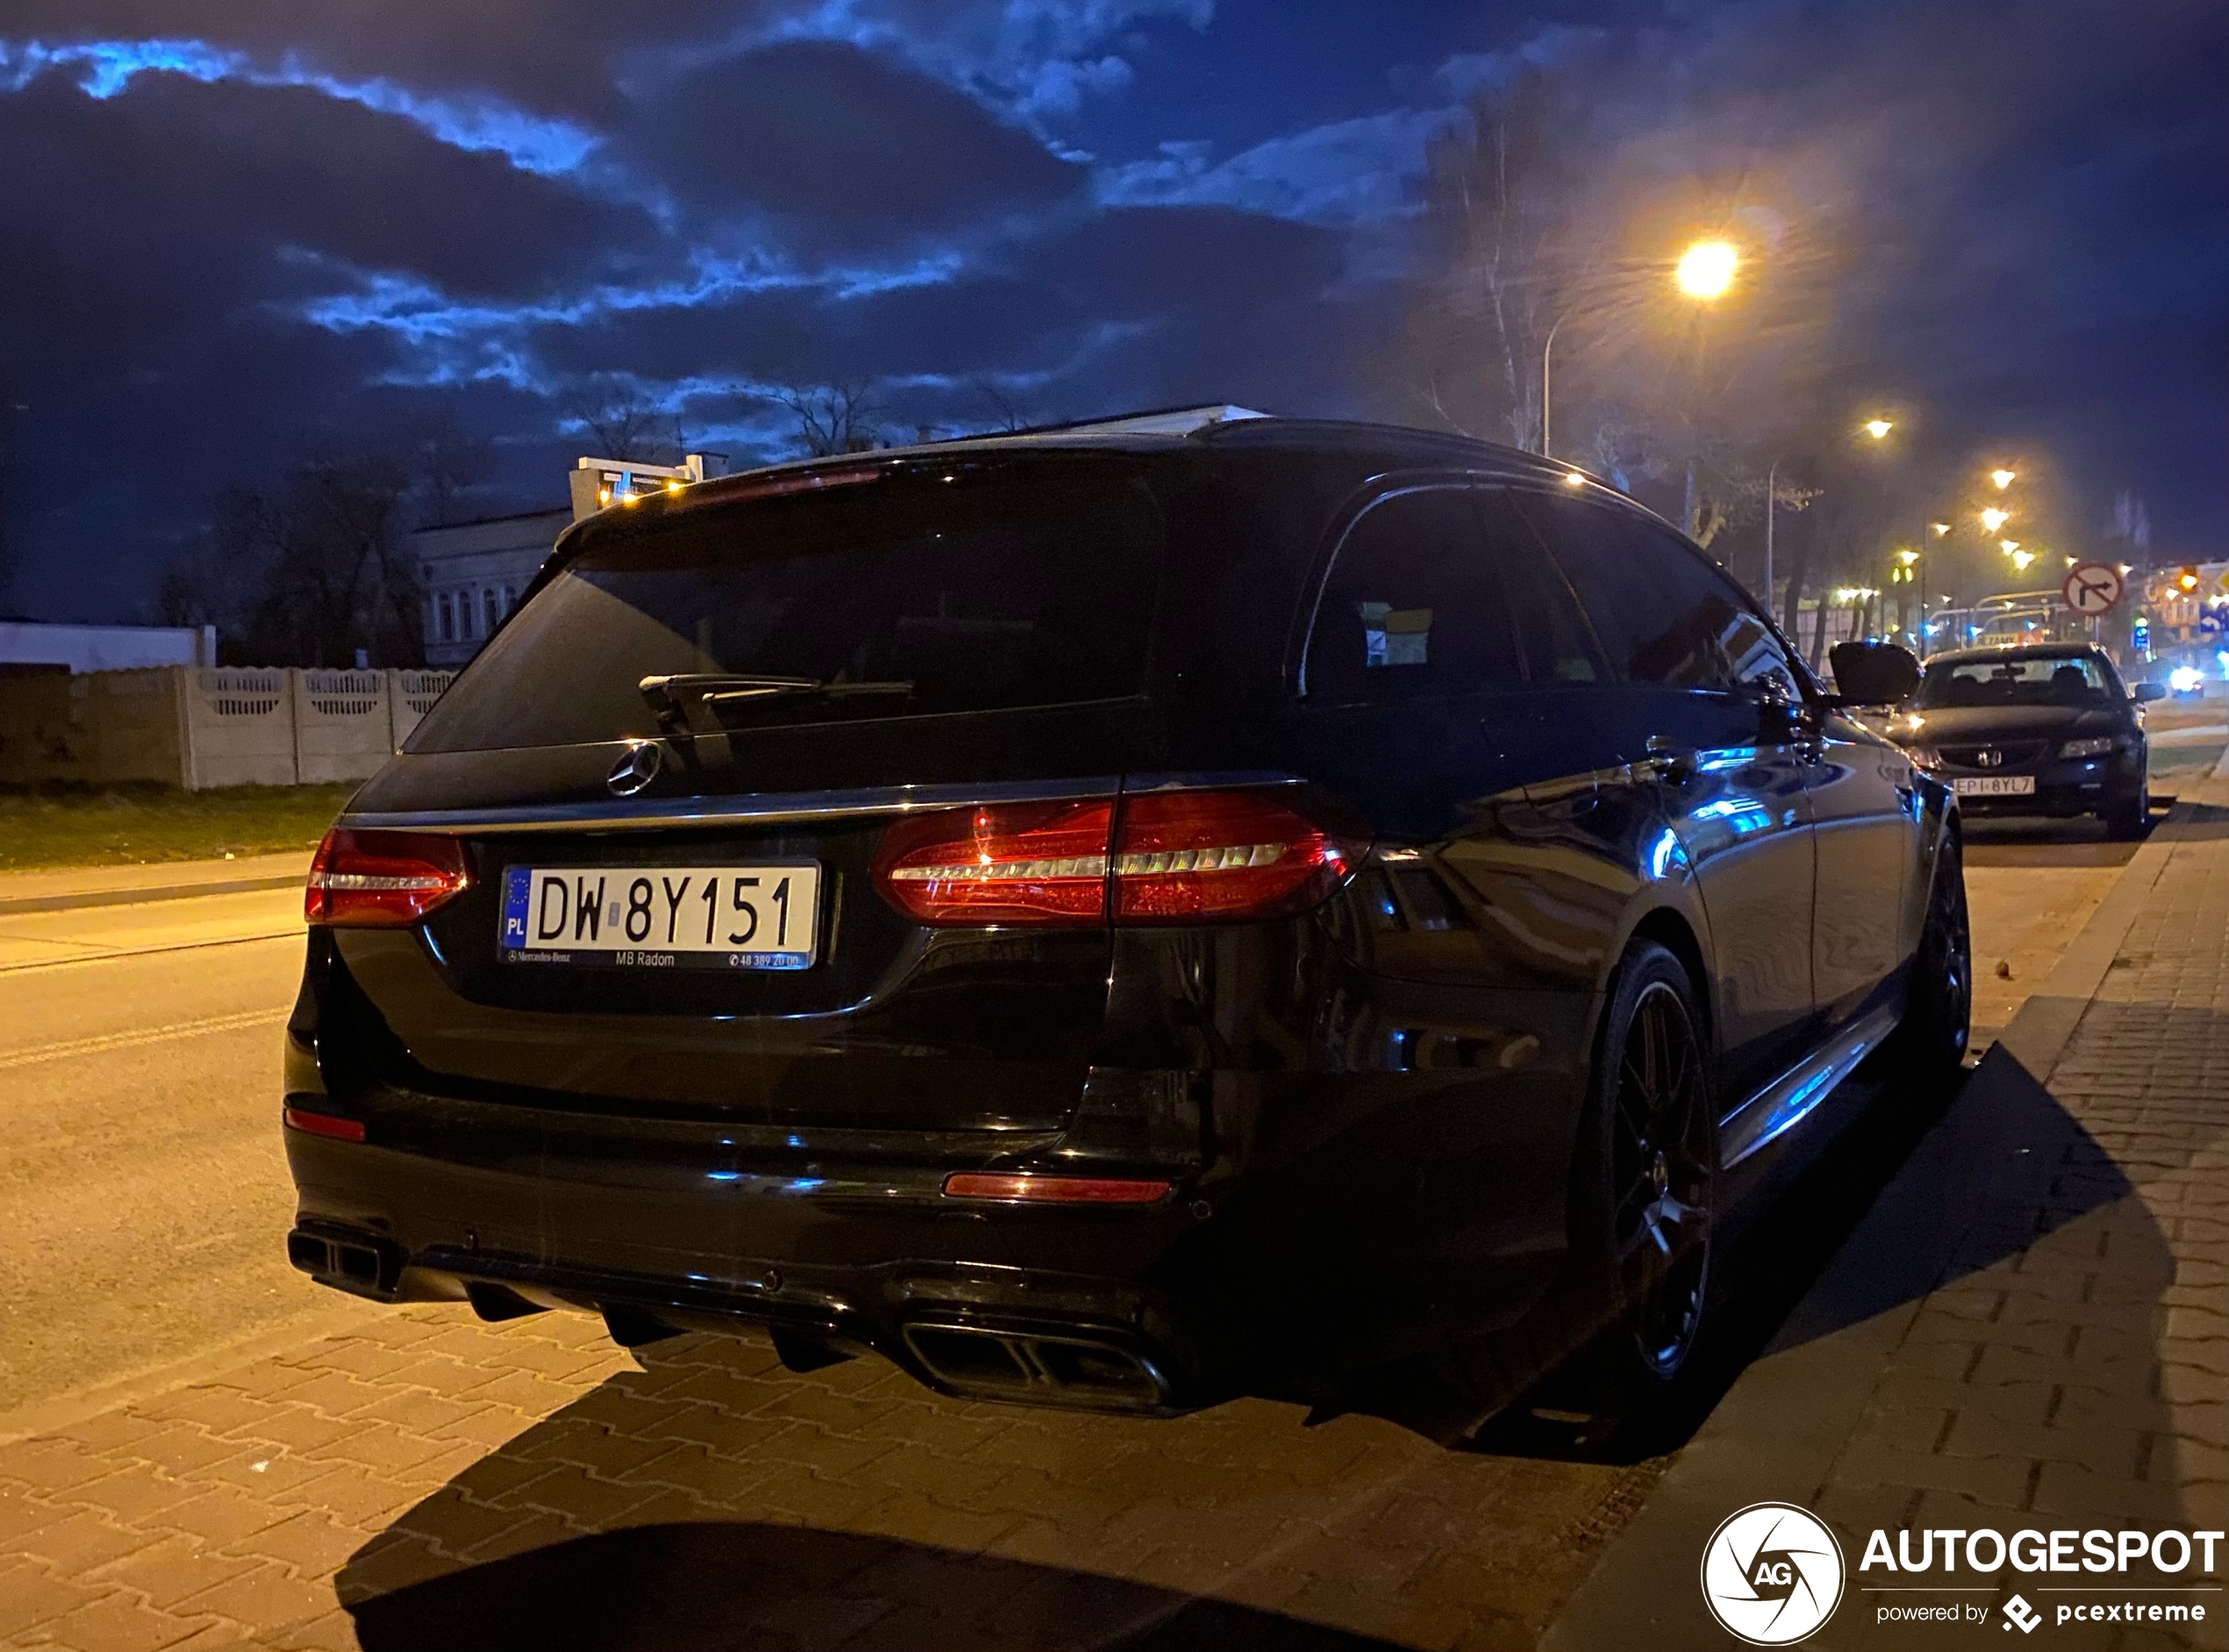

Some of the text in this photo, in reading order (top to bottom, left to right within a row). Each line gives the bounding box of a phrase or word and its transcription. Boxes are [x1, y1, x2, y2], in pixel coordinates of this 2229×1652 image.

[1992, 777, 2030, 792] 8YL7
[537, 876, 792, 946] DW 8Y151
[507, 918, 524, 936] PL
[518, 951, 570, 962] Mercedes-Benz
[616, 951, 675, 966] MB Radom
[740, 955, 751, 966] 48
[754, 955, 770, 966] 389
